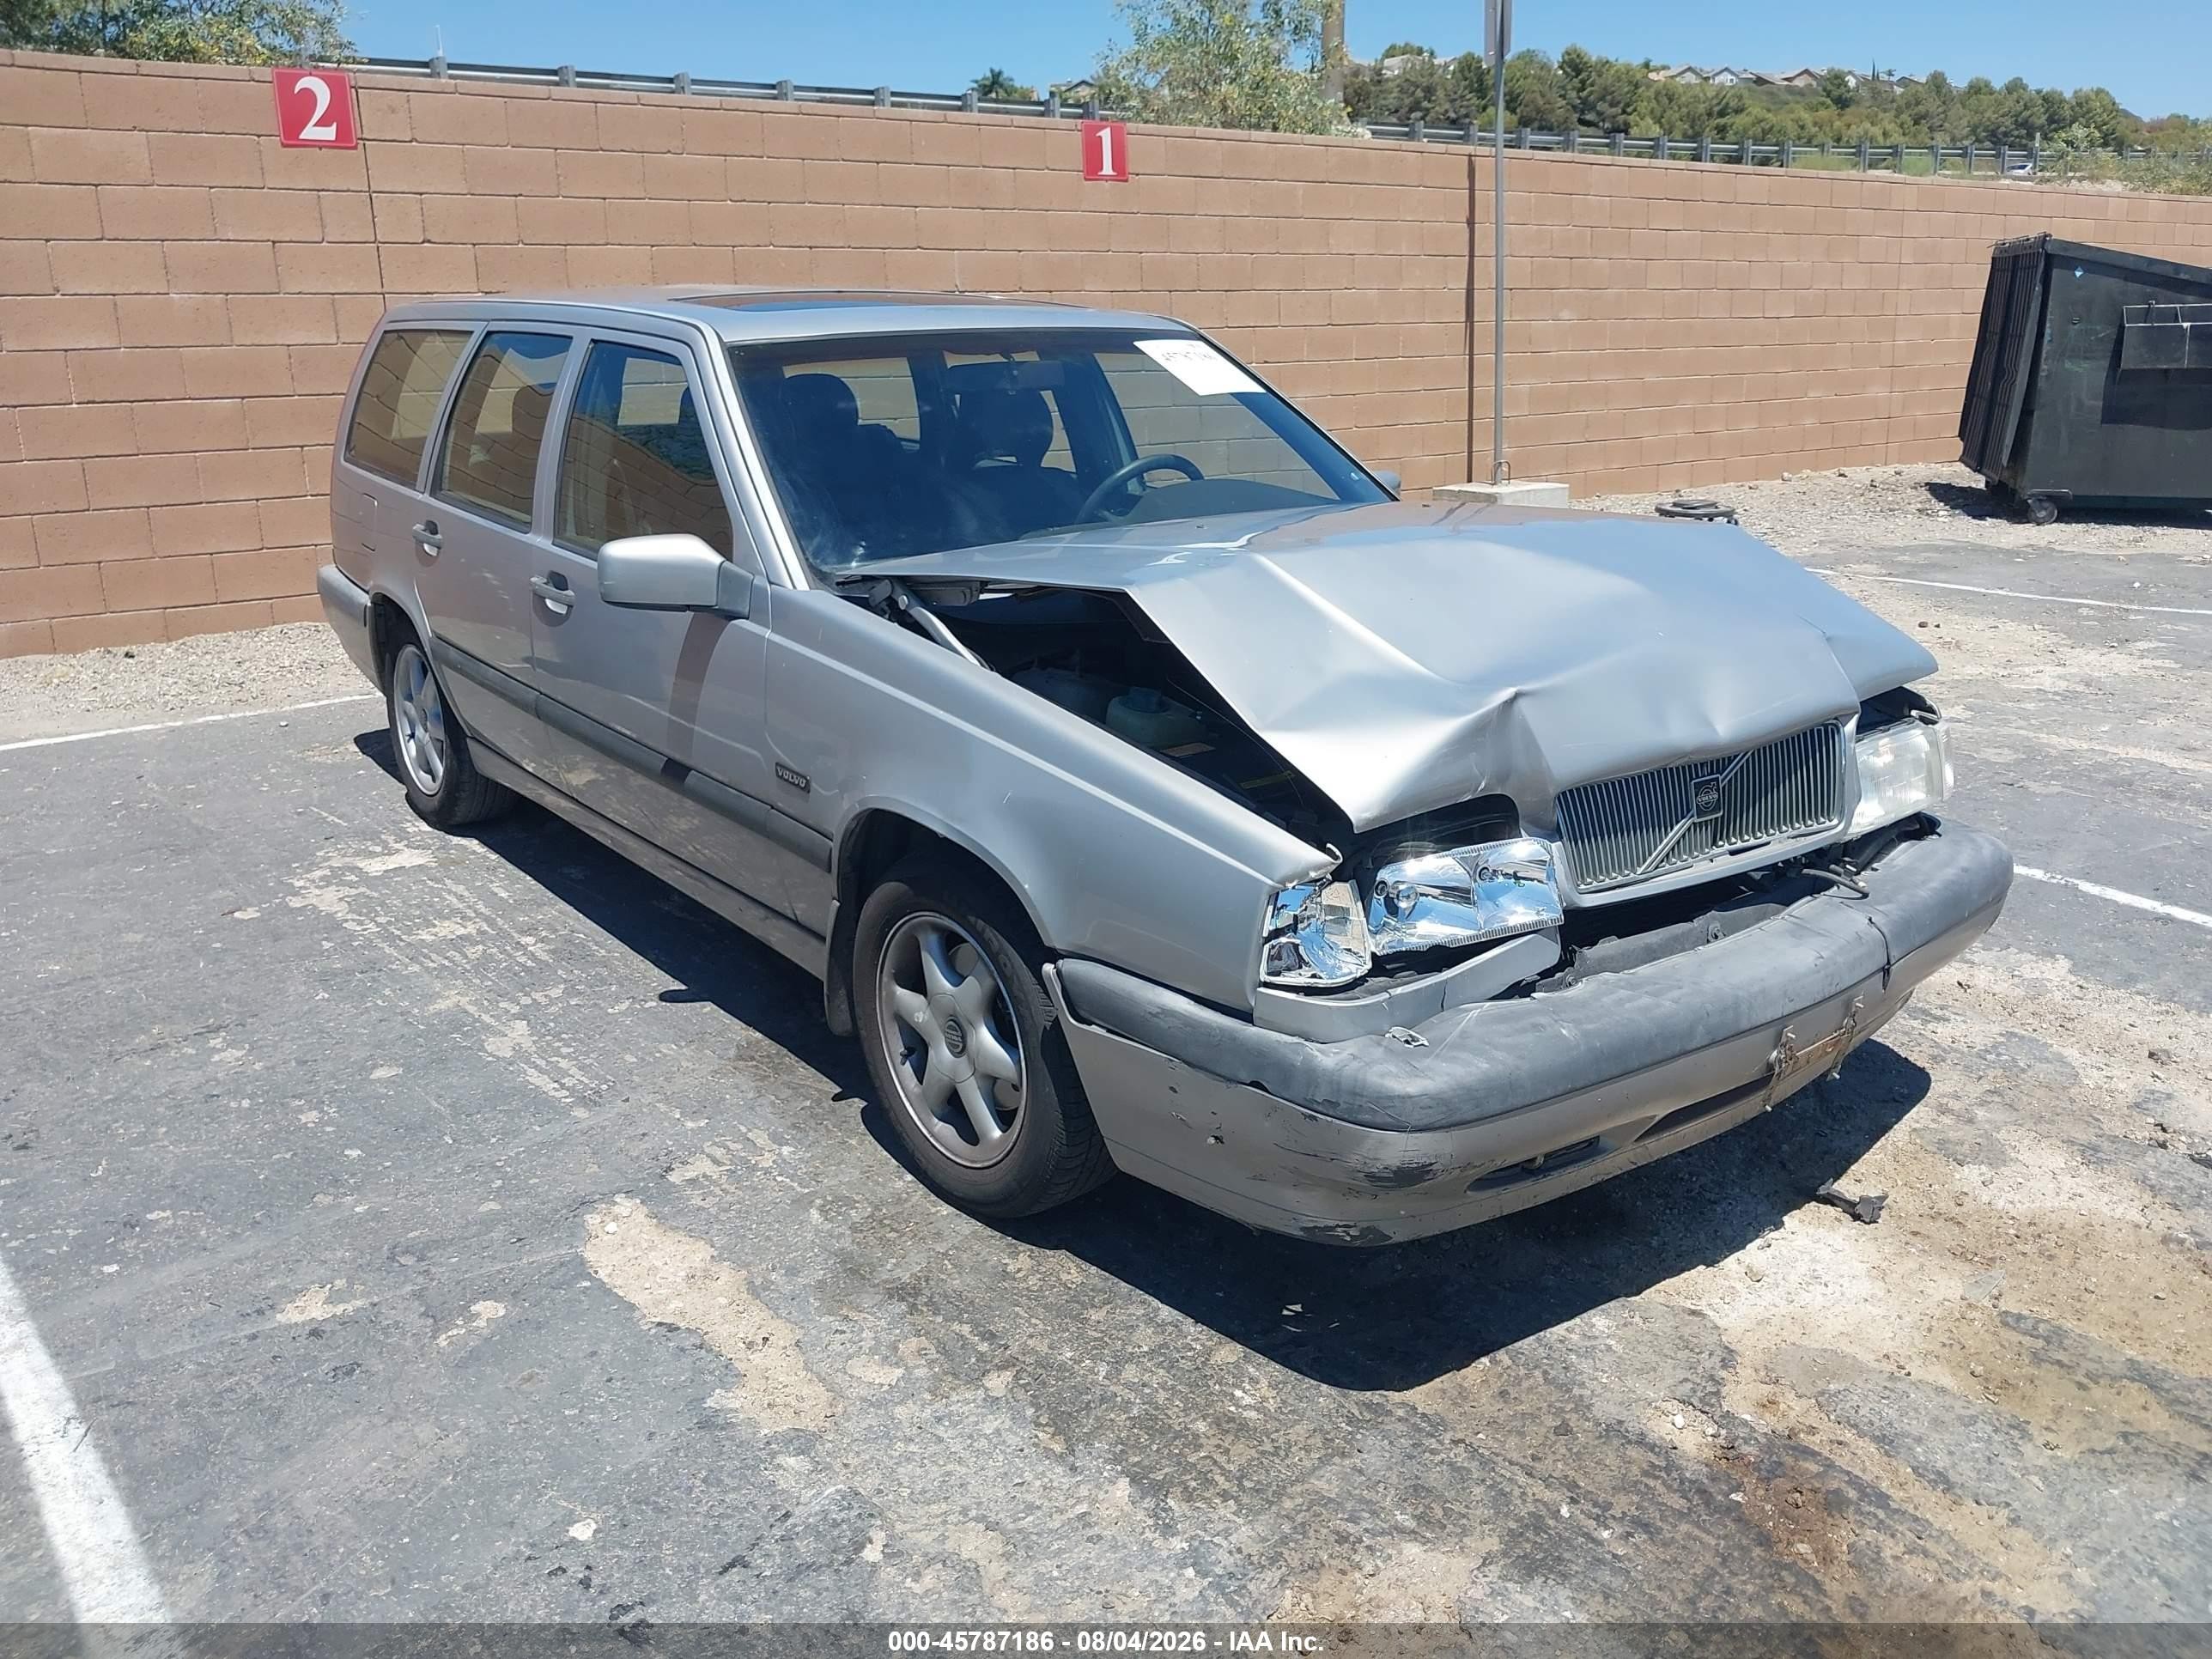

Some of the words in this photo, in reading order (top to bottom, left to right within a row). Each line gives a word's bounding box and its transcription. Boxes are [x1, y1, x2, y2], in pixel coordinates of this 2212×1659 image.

[294, 76, 337, 141] 2
[1095, 126, 1118, 175] 1
[776, 766, 806, 787] VOLVO
